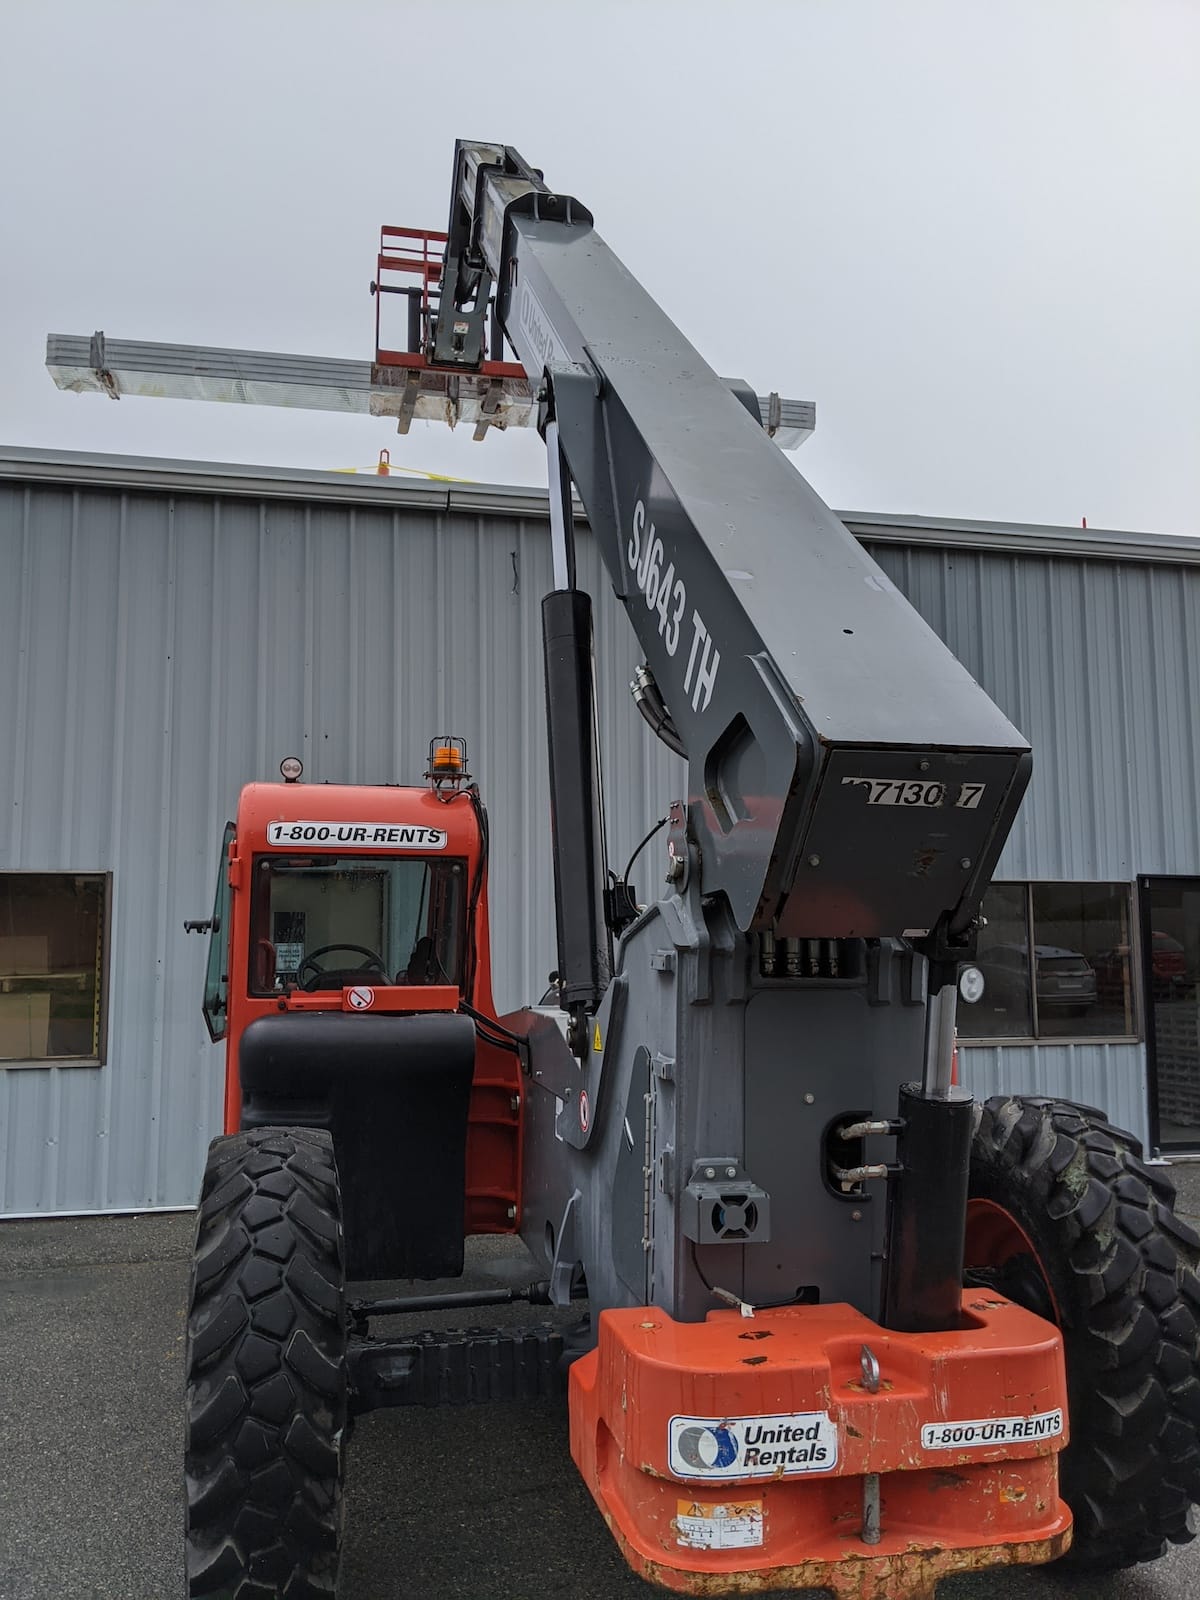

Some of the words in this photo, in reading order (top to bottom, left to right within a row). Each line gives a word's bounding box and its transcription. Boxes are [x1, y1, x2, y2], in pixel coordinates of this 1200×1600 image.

[628, 500, 687, 656] SJ643
[683, 608, 721, 713] TH
[273, 826, 441, 843] 1-800-UR-RENTS
[744, 1422, 821, 1446] United
[927, 1414, 1060, 1444] 1-800-UR-RENTS
[743, 1443, 827, 1467] Rentals
